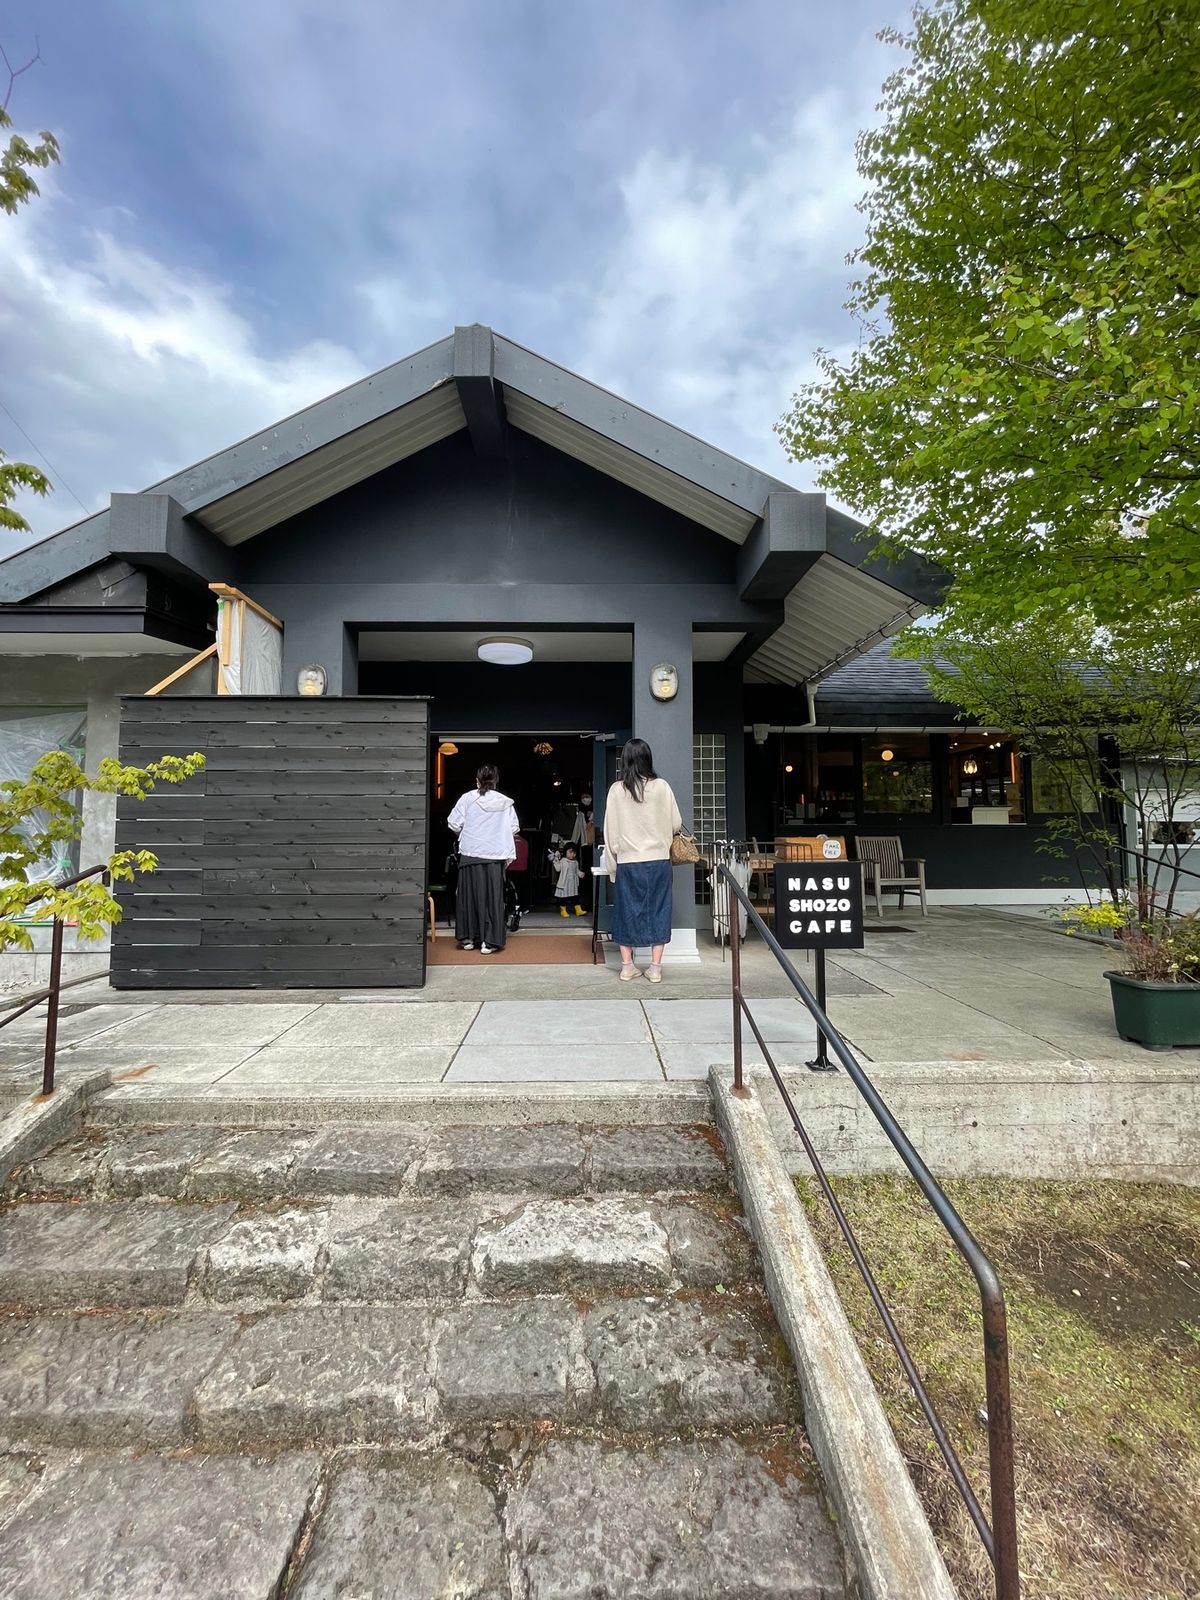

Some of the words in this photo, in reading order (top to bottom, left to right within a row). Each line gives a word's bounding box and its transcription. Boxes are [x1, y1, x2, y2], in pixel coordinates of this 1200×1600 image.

[788, 877, 850, 891] NASU
[789, 898, 851, 912] SHOZO
[789, 920, 852, 933] CAFE
